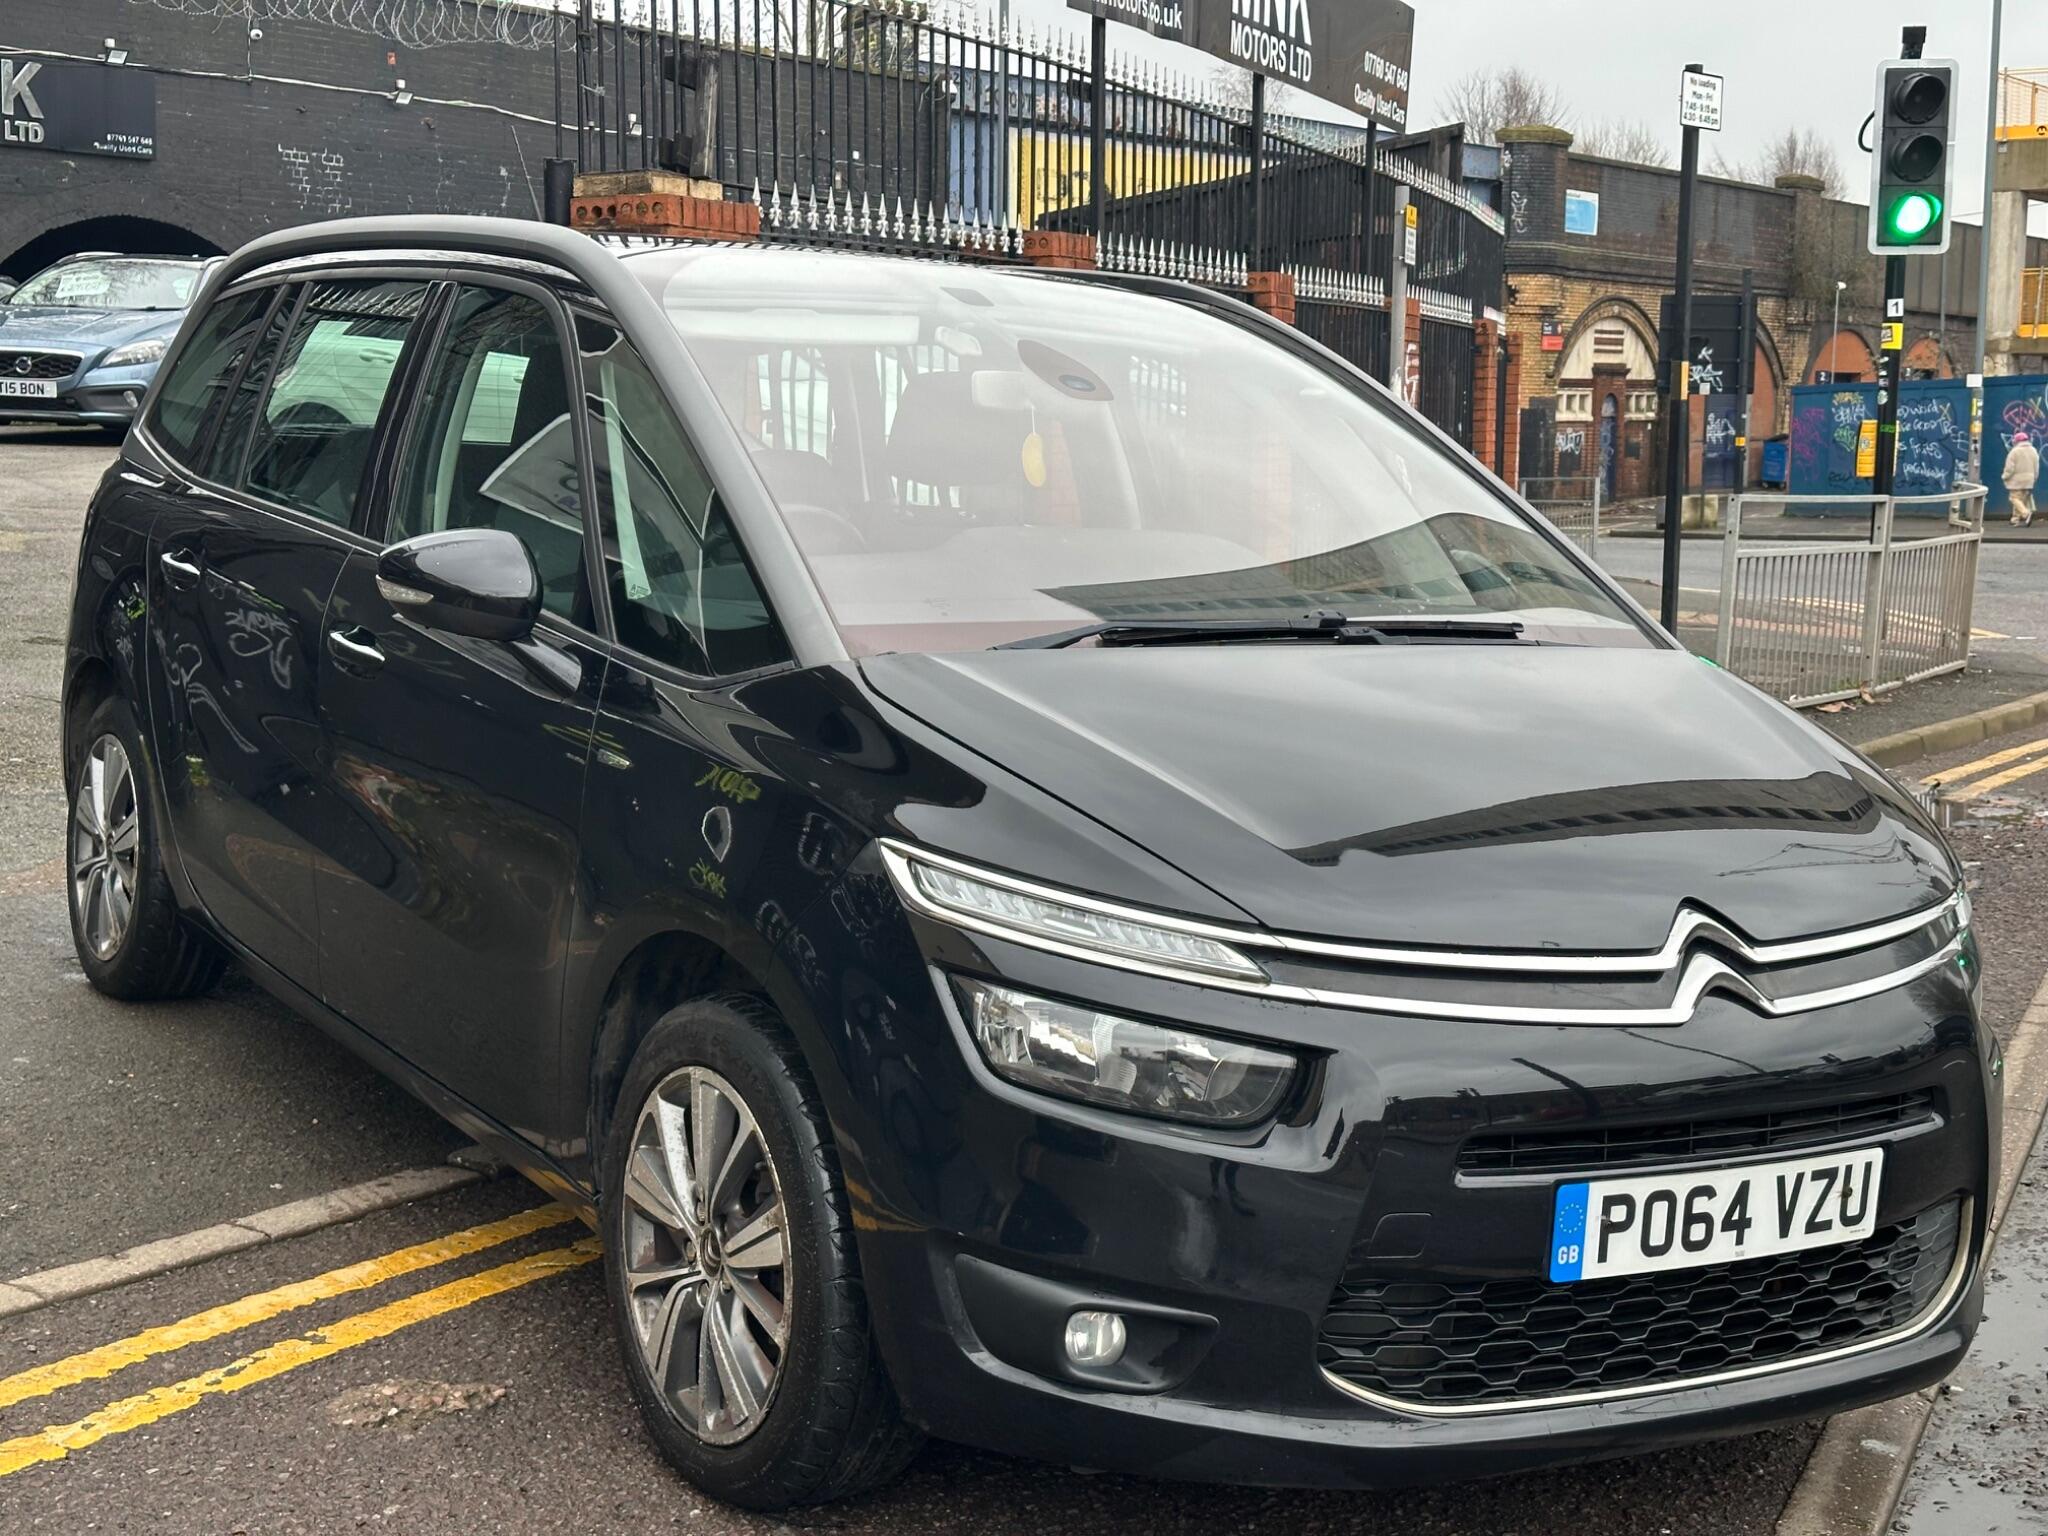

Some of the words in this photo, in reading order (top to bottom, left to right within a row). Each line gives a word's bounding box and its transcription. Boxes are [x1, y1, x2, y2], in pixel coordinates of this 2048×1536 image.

[1230, 19, 1286, 73] MOTORS
[1289, 44, 1312, 82] LTD
[1354, 83, 1376, 115] Quality
[1376, 93, 1392, 118] Used
[1392, 101, 1405, 125] Cars
[4, 119, 44, 143] LTD
[1891, 301, 1899, 314] 1
[20, 382, 45, 395] BON
[1776, 1160, 1874, 1239] VZU
[1557, 1245, 1580, 1265] GB
